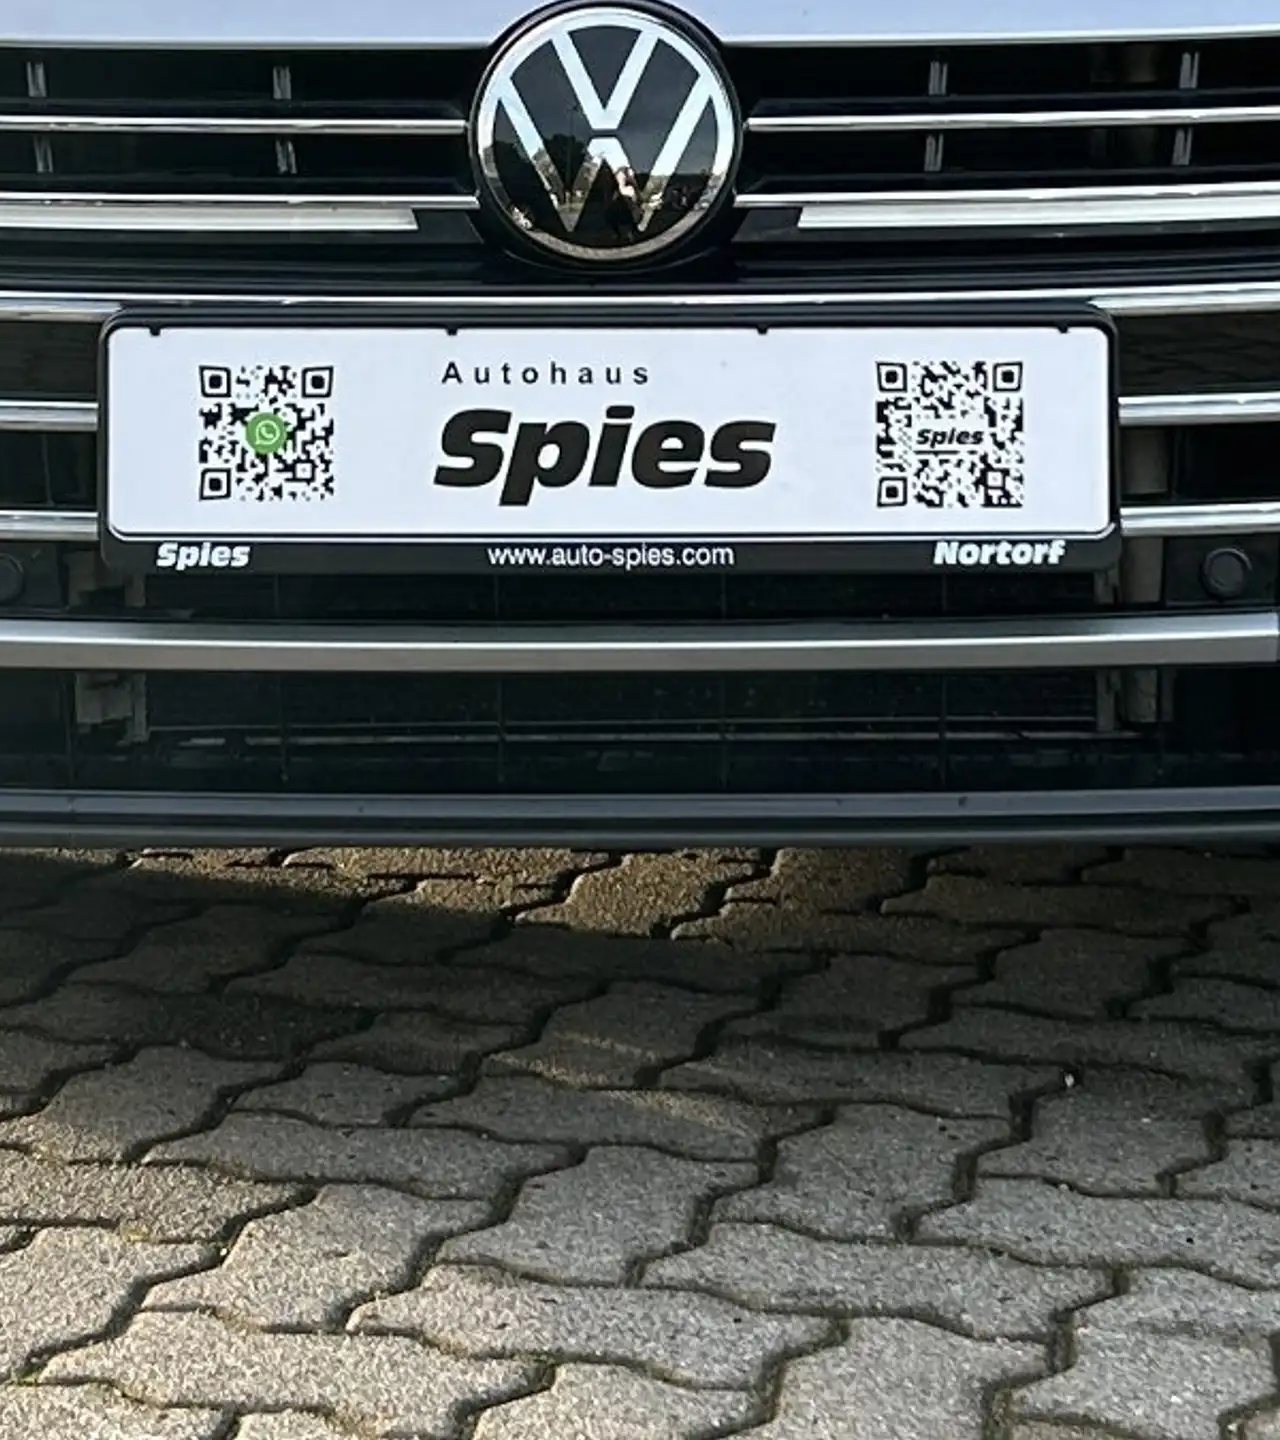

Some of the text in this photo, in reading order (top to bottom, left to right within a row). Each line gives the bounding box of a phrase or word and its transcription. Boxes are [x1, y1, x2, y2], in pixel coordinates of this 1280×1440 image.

[441, 361, 649, 385] Autohaus
[916, 427, 985, 449] Spies
[433, 405, 777, 507] Spies
[156, 542, 251, 571] Spies
[487, 543, 735, 571] www.auto-spies.com
[933, 541, 1066, 566] Nortorf
